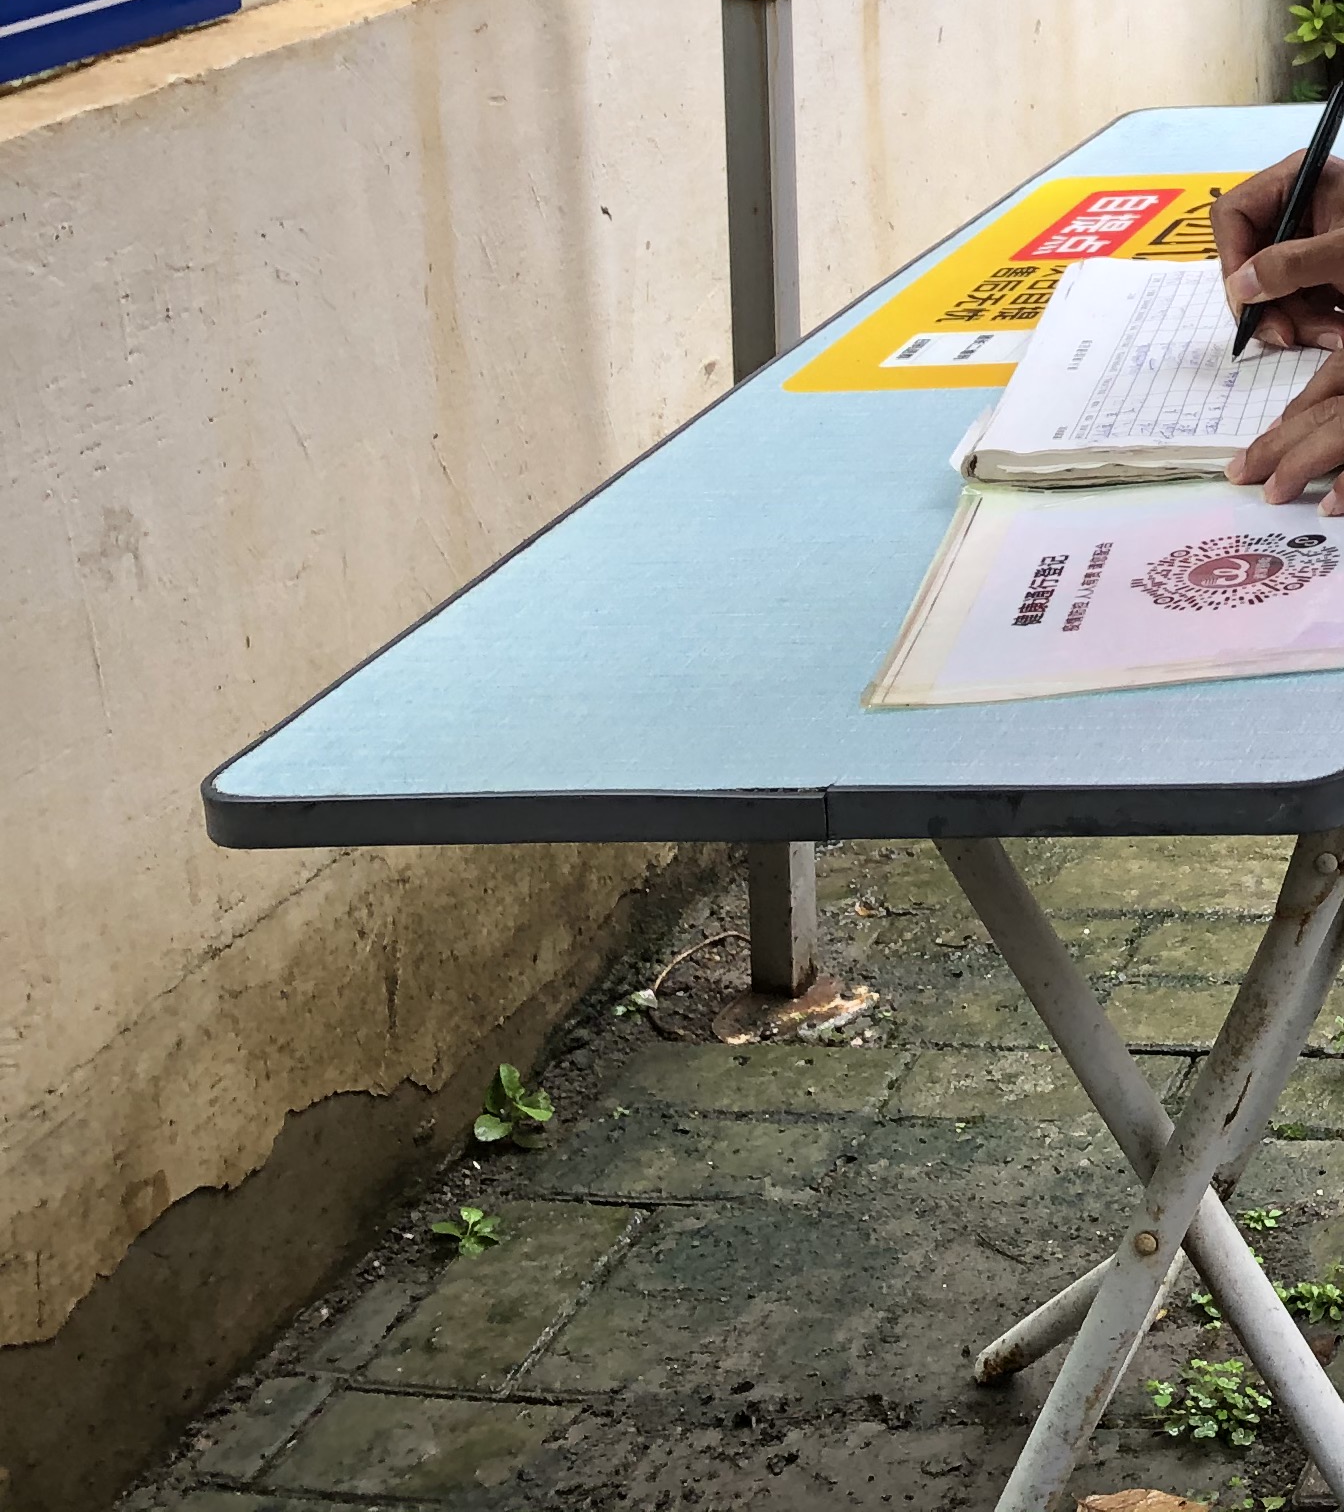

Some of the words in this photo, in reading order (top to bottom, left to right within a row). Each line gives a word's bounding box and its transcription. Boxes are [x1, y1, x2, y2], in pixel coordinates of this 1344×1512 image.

[1032, 194, 1159, 255] 自提点
[935, 265, 1040, 323] 售后无忧
[1010, 554, 1070, 627] 健康通行登记
